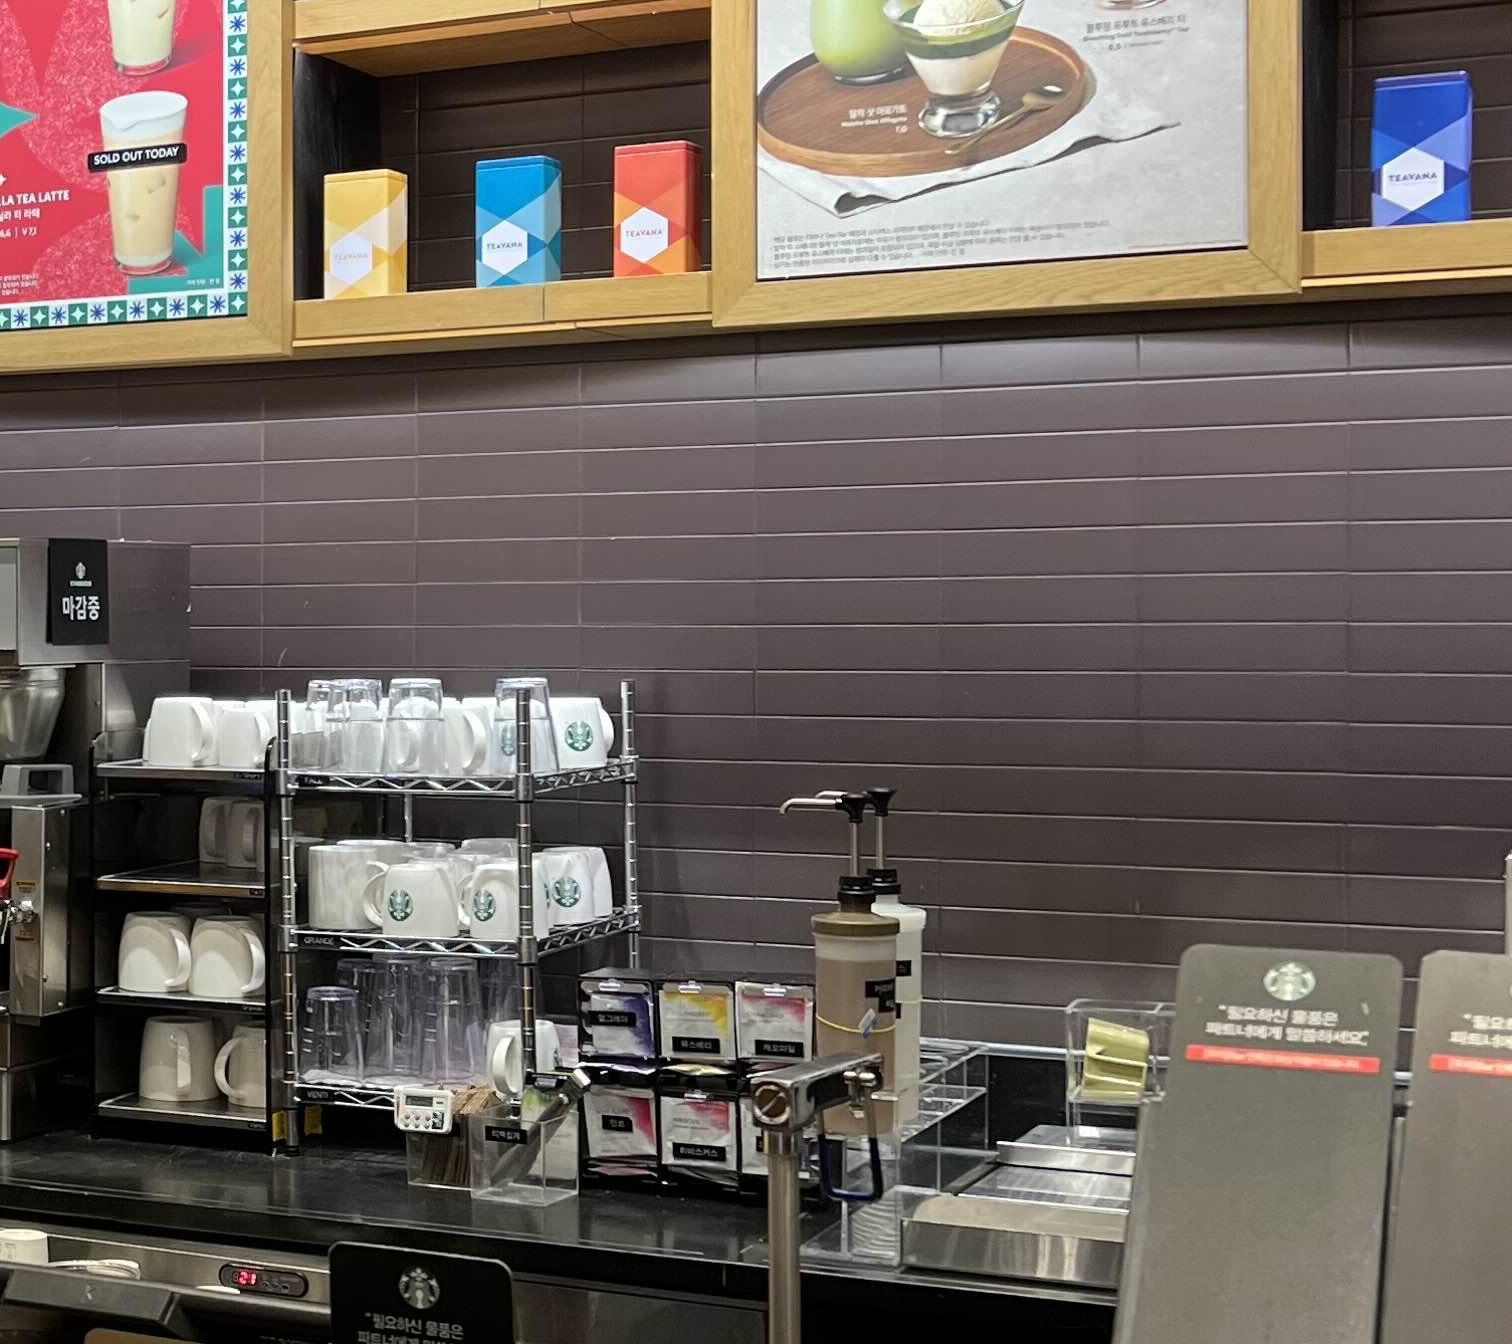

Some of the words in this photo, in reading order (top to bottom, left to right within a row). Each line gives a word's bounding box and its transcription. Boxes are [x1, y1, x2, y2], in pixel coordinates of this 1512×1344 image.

[94, 153, 120, 165] SOLD
[122, 150, 144, 162] OUT
[145, 146, 179, 159] TODAY
[15, 194, 36, 204] TEA
[38, 190, 69, 203] LATTE
[62, 596, 100, 620] 마감중
[426, 1321, 464, 1340] 물품은
